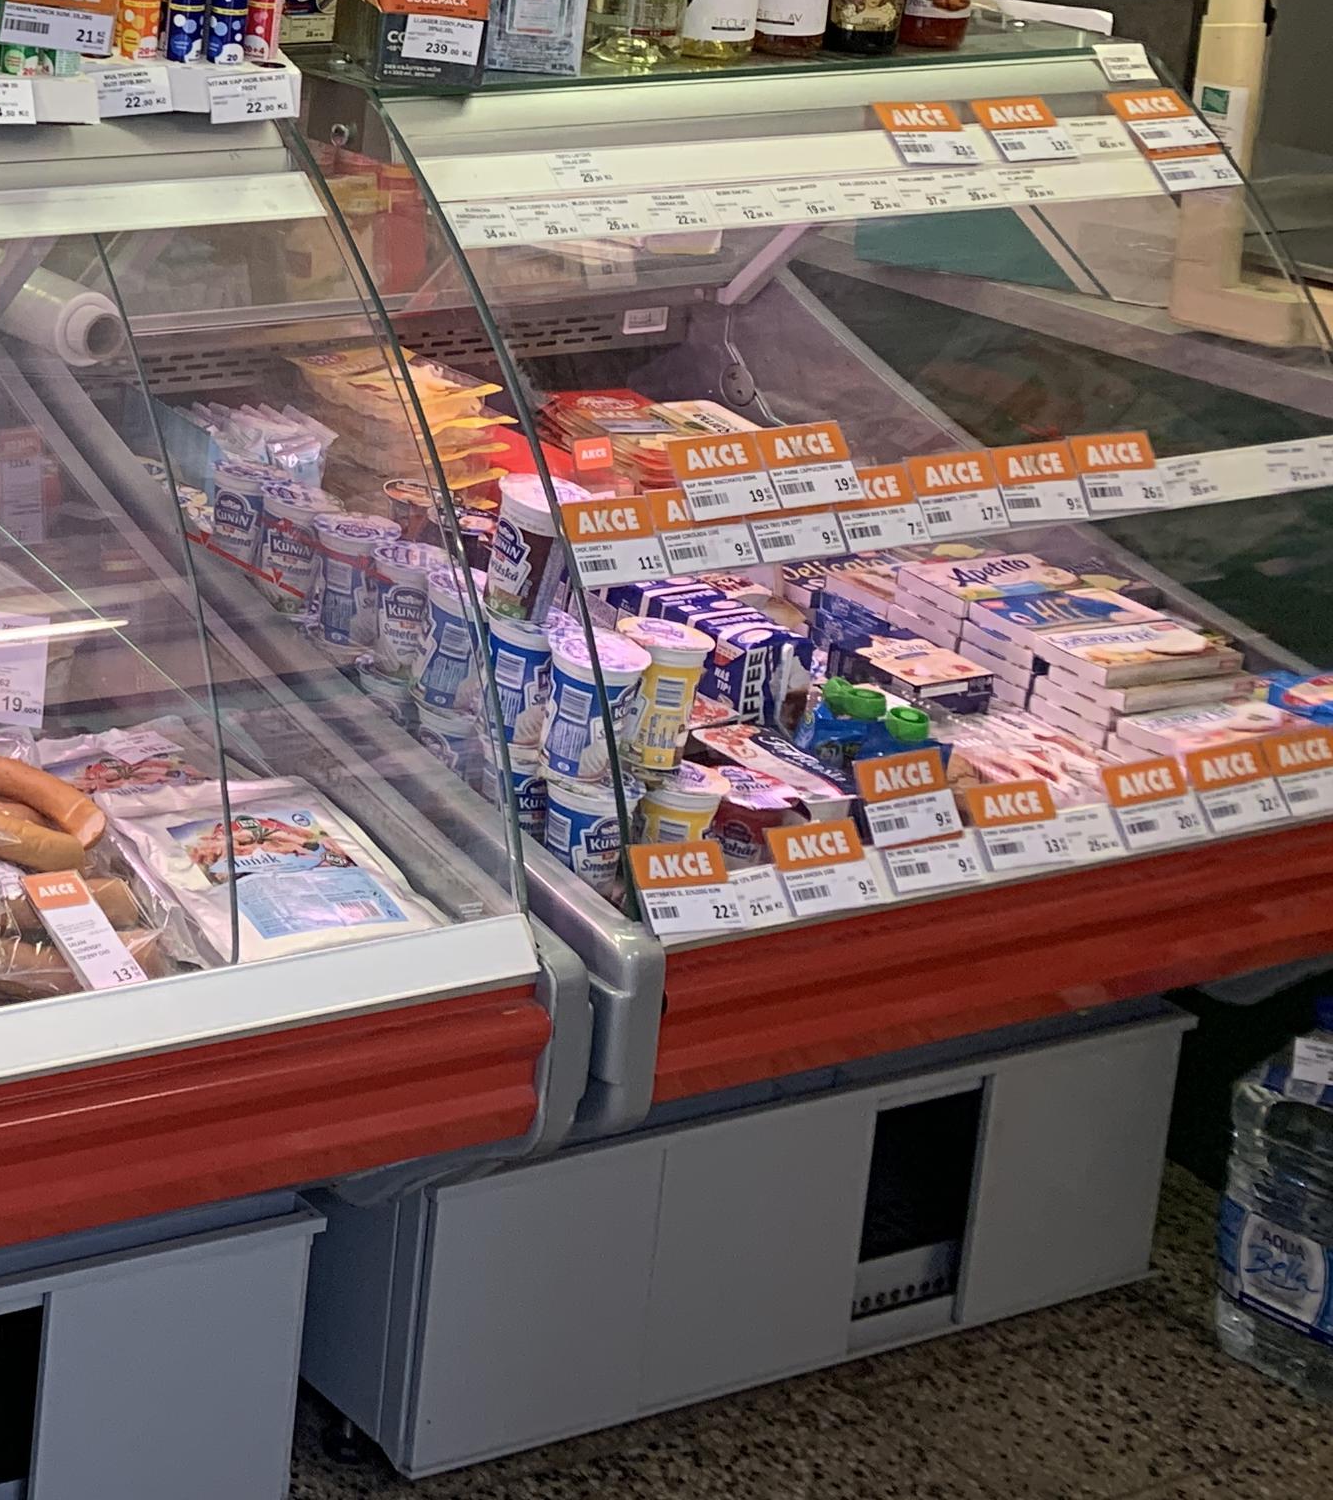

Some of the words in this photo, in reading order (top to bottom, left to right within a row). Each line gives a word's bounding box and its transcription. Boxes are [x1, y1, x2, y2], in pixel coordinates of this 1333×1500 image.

[75, 28, 93, 44] 21
[987, 100, 1042, 122] AKCE
[1123, 93, 1180, 117] AKCE
[686, 442, 748, 471] AKCE
[775, 433, 835, 460] AKCE
[1086, 443, 1143, 466] AKCE
[925, 461, 983, 487] AKCE
[1008, 452, 1065, 478] AKCE
[749, 489, 764, 503] 19
[578, 507, 640, 535] AKCE
[638, 556, 653, 569] 11
[948, 558, 1031, 588] Apetito
[1279, 738, 1332, 767] AKCE
[875, 761, 934, 794] AKCE
[1201, 752, 1257, 782] AKCE
[1119, 768, 1176, 798] AKCE
[984, 792, 1043, 819] AKCE
[786, 831, 851, 862] AKCE
[649, 851, 714, 880] AKCE
[37, 882, 76, 901] AKCE
[713, 905, 730, 920] 22
[1261, 1229, 1307, 1260] AQUA
[1245, 1245, 1319, 1292] Bella
